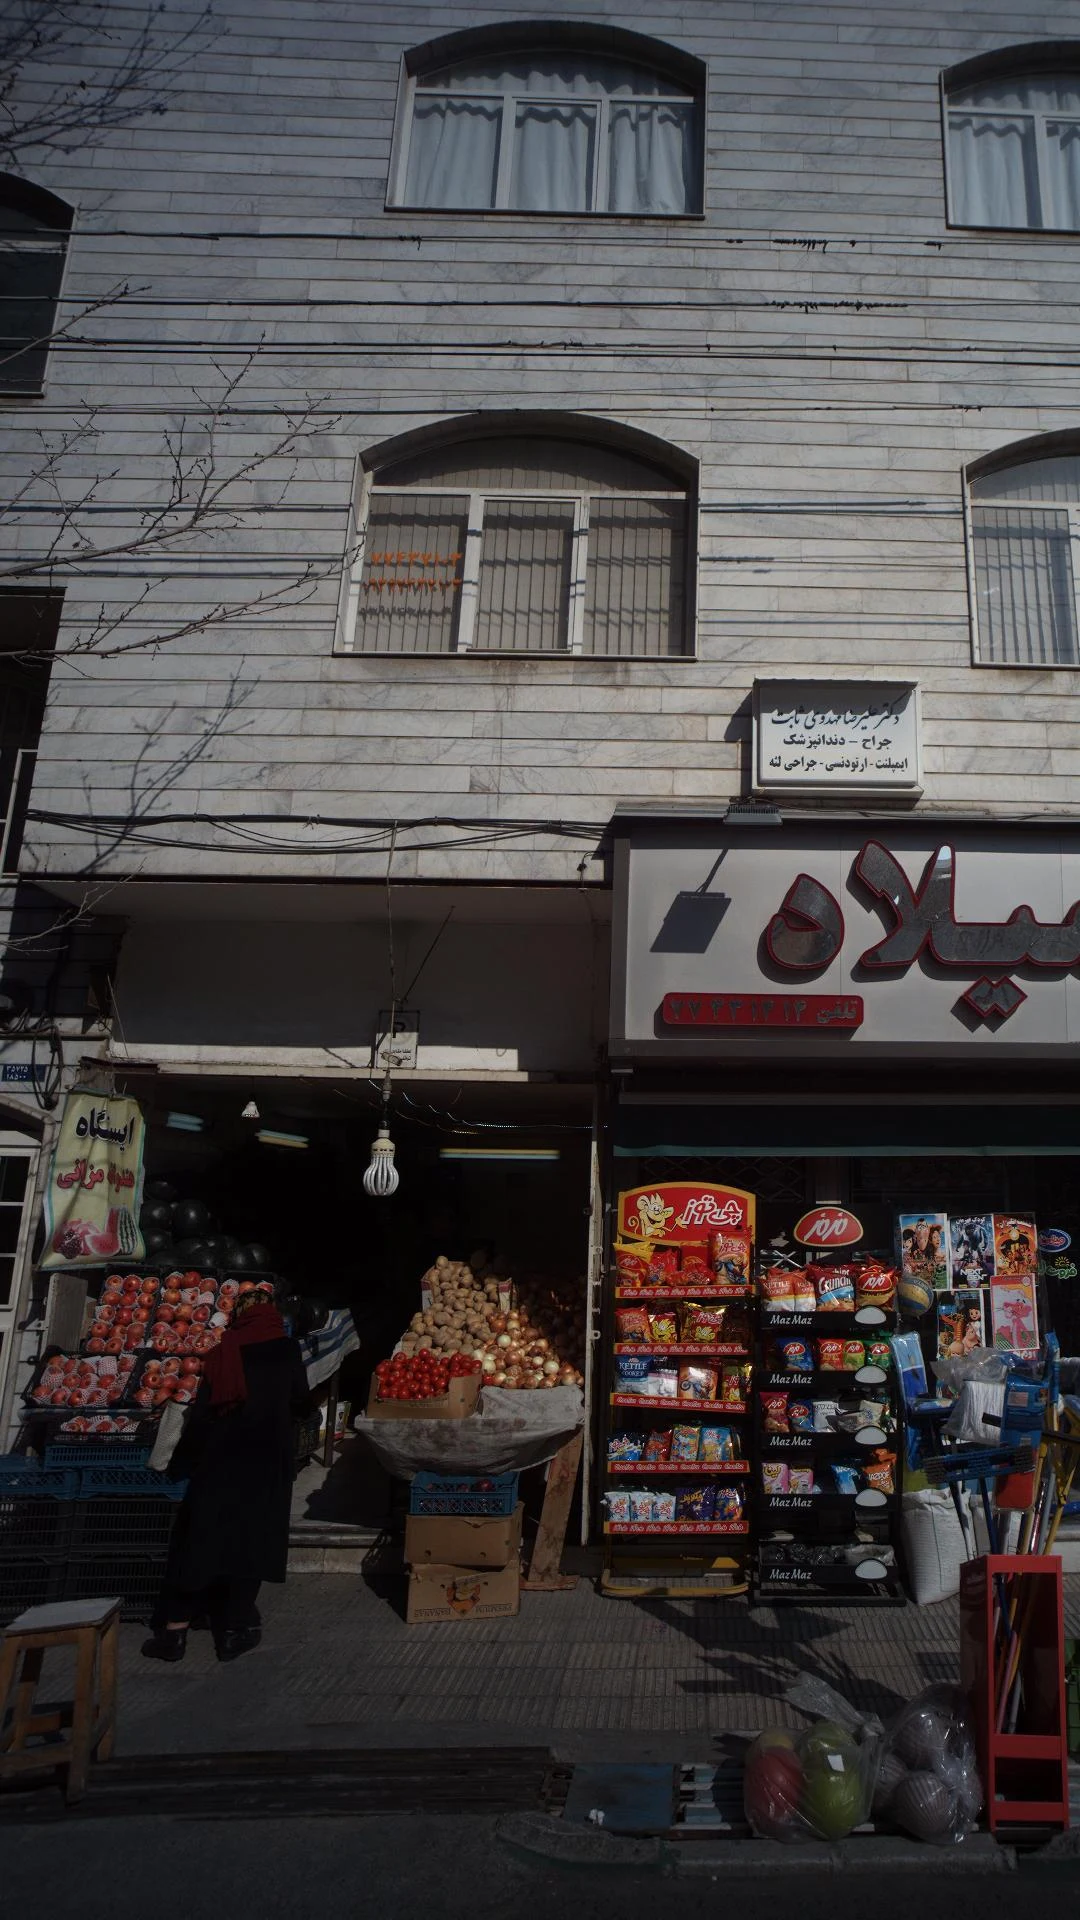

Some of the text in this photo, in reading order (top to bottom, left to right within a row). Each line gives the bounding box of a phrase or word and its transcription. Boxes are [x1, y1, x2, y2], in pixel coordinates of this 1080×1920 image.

[783, 733, 892, 750] جراح دندانپزشک
[784, 756, 817, 771] جراحی
[825, 756, 868, 772] ارتودنسی
[875, 757, 908, 773] ایمپلنت
[766, 839, 1080, 1019] یلاد
[75, 1108, 135, 1151] ایستگاه
[803, 1211, 849, 1242] مزمز
[769, 1314, 812, 1325] Maz Maz
[769, 1373, 812, 1384] Maz Maz
[769, 1435, 812, 1446] Maz Maz
[769, 1496, 812, 1507] Maz Maz
[769, 1568, 812, 1580] Maz Maz
